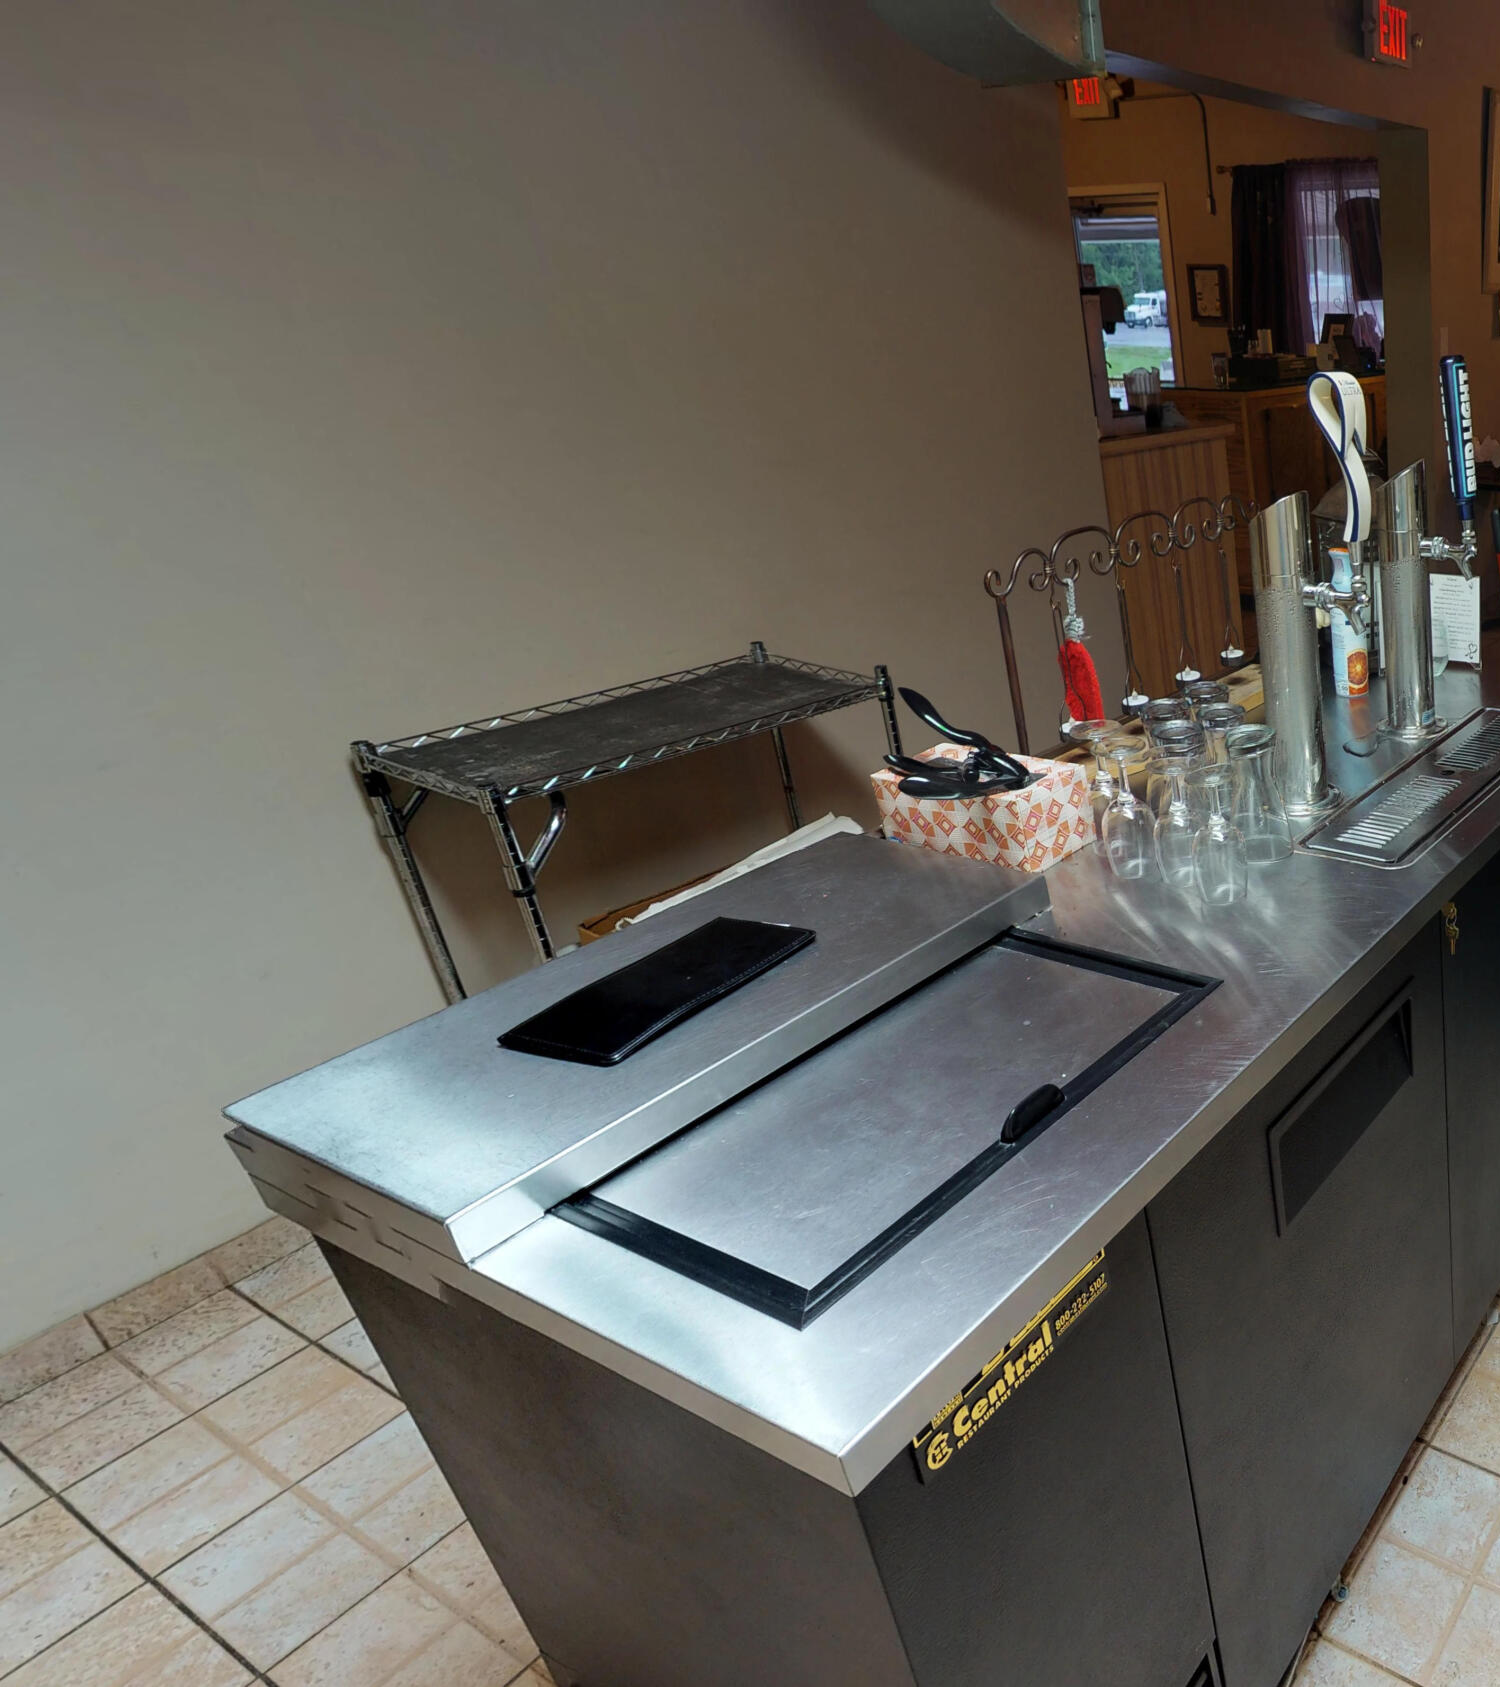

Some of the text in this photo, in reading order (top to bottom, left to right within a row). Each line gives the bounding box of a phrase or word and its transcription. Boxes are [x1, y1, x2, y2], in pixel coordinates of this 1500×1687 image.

[1379, 0, 1407, 60] EXIT
[1073, 77, 1100, 105] EXIT
[1458, 369, 1477, 492] BUD LIGHT
[1055, 1273, 1105, 1330] 800-222-5107
[952, 1320, 1053, 1437] Central
[956, 1387, 1012, 1449] RESTAURANT
[1014, 1344, 1055, 1388] PRODUCTS
